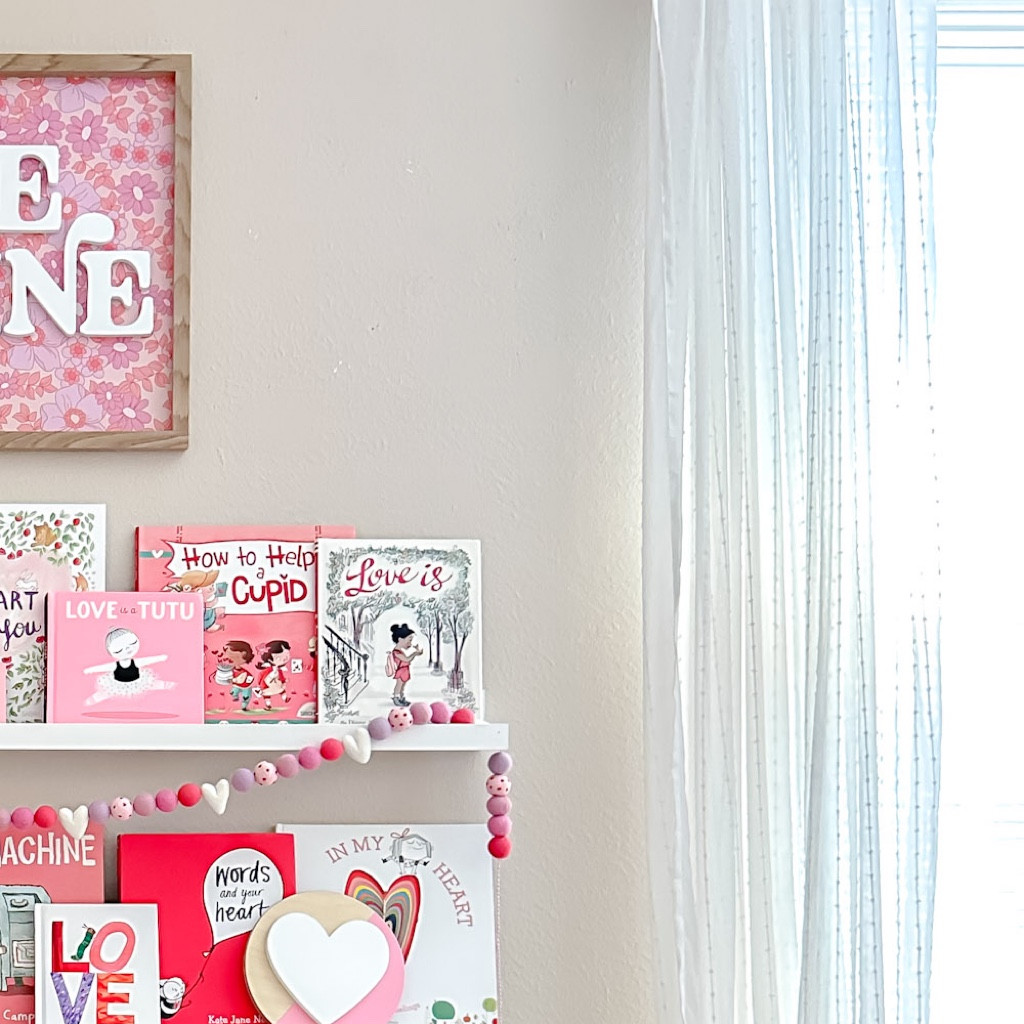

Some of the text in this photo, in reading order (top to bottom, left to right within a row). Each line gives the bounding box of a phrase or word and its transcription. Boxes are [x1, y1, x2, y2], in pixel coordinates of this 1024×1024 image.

[182, 544, 316, 572] How to Help
[257, 567, 265, 579] a
[345, 558, 453, 597] Love is
[65, 600, 118, 619] LOVE
[120, 606, 128, 614] is
[137, 601, 195, 619] TUTU
[325, 836, 384, 864] IN MY
[219, 887, 265, 905] and your
[432, 862, 473, 927] HEART
[216, 899, 270, 922] heart
[207, 1014, 228, 1024] Kate
[230, 1014, 251, 1024] Jane
